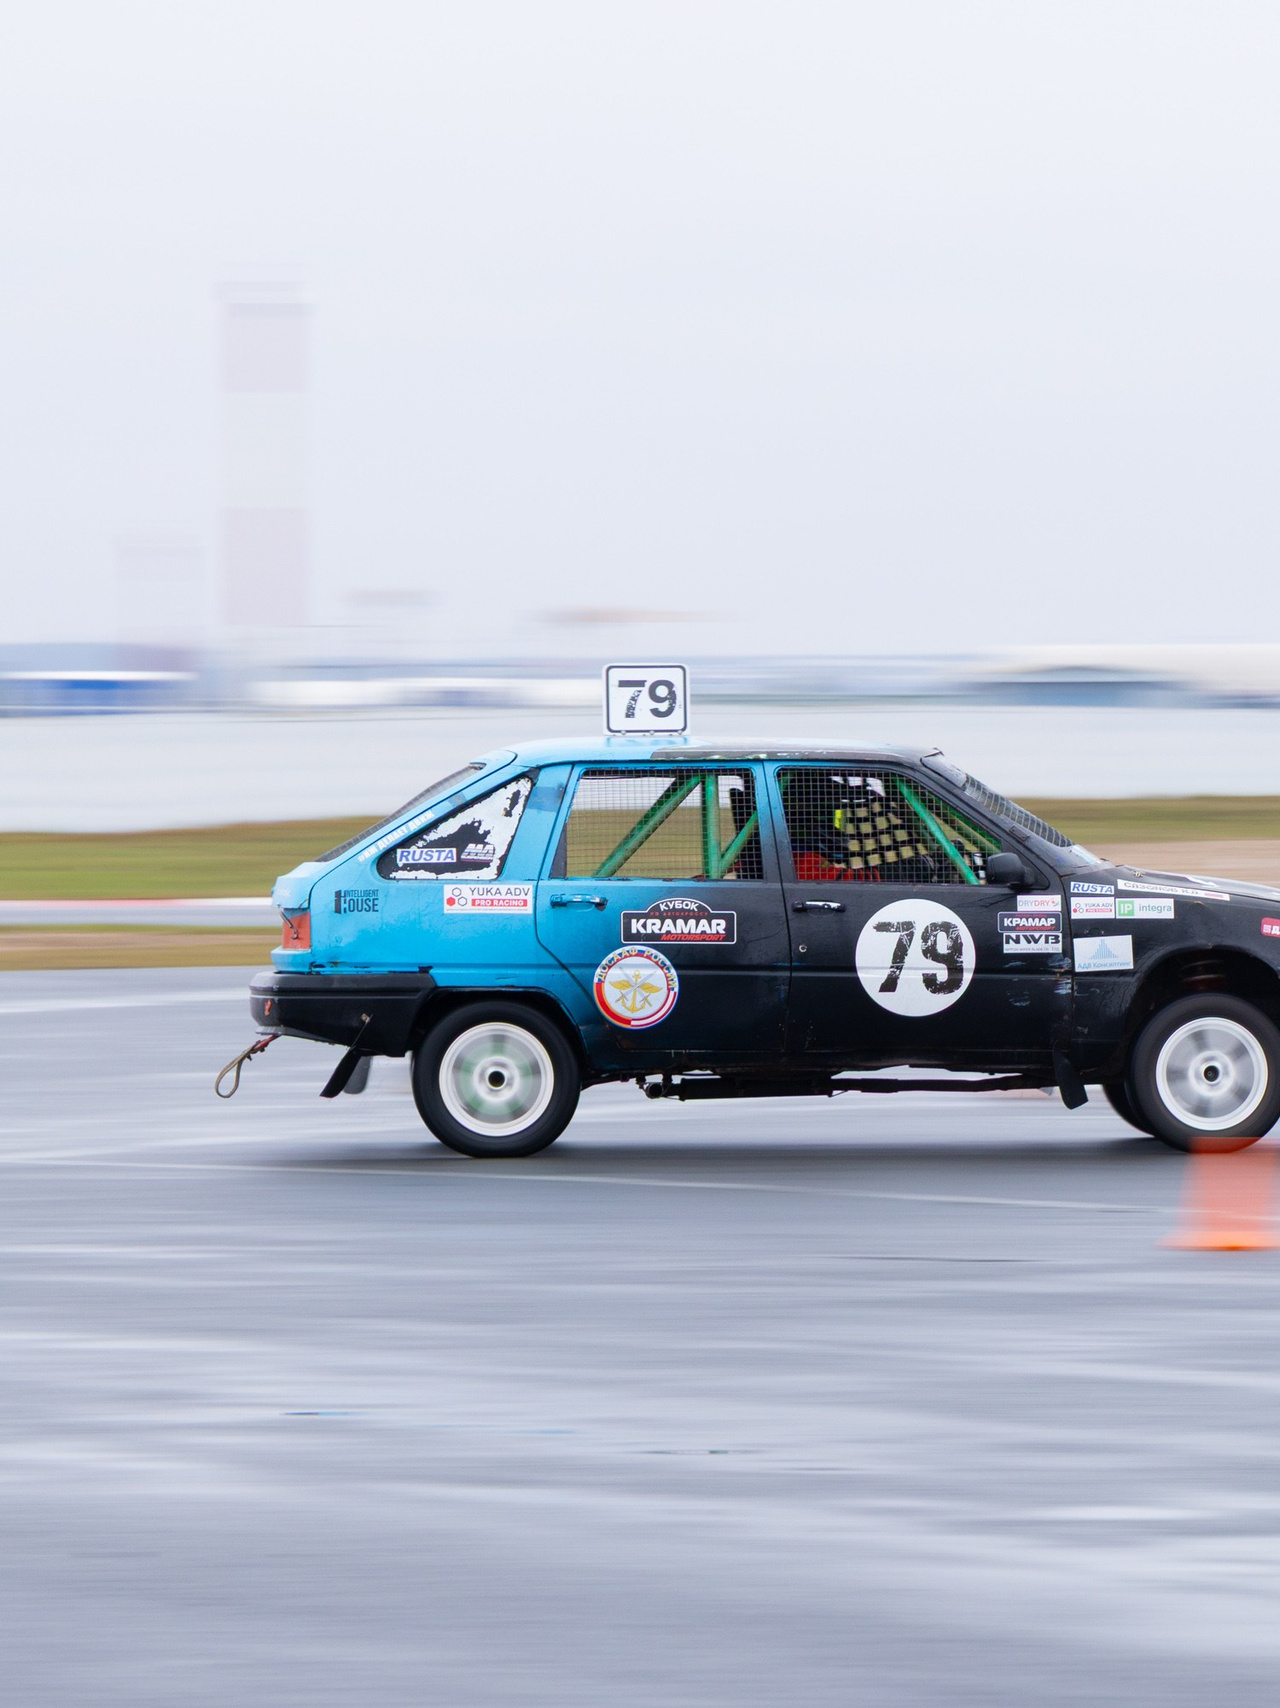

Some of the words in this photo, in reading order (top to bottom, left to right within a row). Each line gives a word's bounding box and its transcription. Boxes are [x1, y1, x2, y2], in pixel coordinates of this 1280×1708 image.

[617, 679, 677, 718] 79
[399, 849, 455, 862] RUSTA
[469, 887, 502, 896] YUKA
[505, 887, 530, 896] ADV
[1072, 882, 1114, 894] RUSTA
[493, 899, 524, 907] RACING
[659, 900, 700, 911] КУБОК
[1139, 903, 1172, 913] integra
[1120, 904, 1132, 914] IP
[631, 918, 727, 934] KRAMAR
[1004, 918, 1056, 926] КРАМАР
[1005, 934, 1060, 945] NWB
[873, 920, 964, 995] 79
[596, 946, 638, 981] ДОСААФ
[644, 948, 677, 989] РОССИИ
